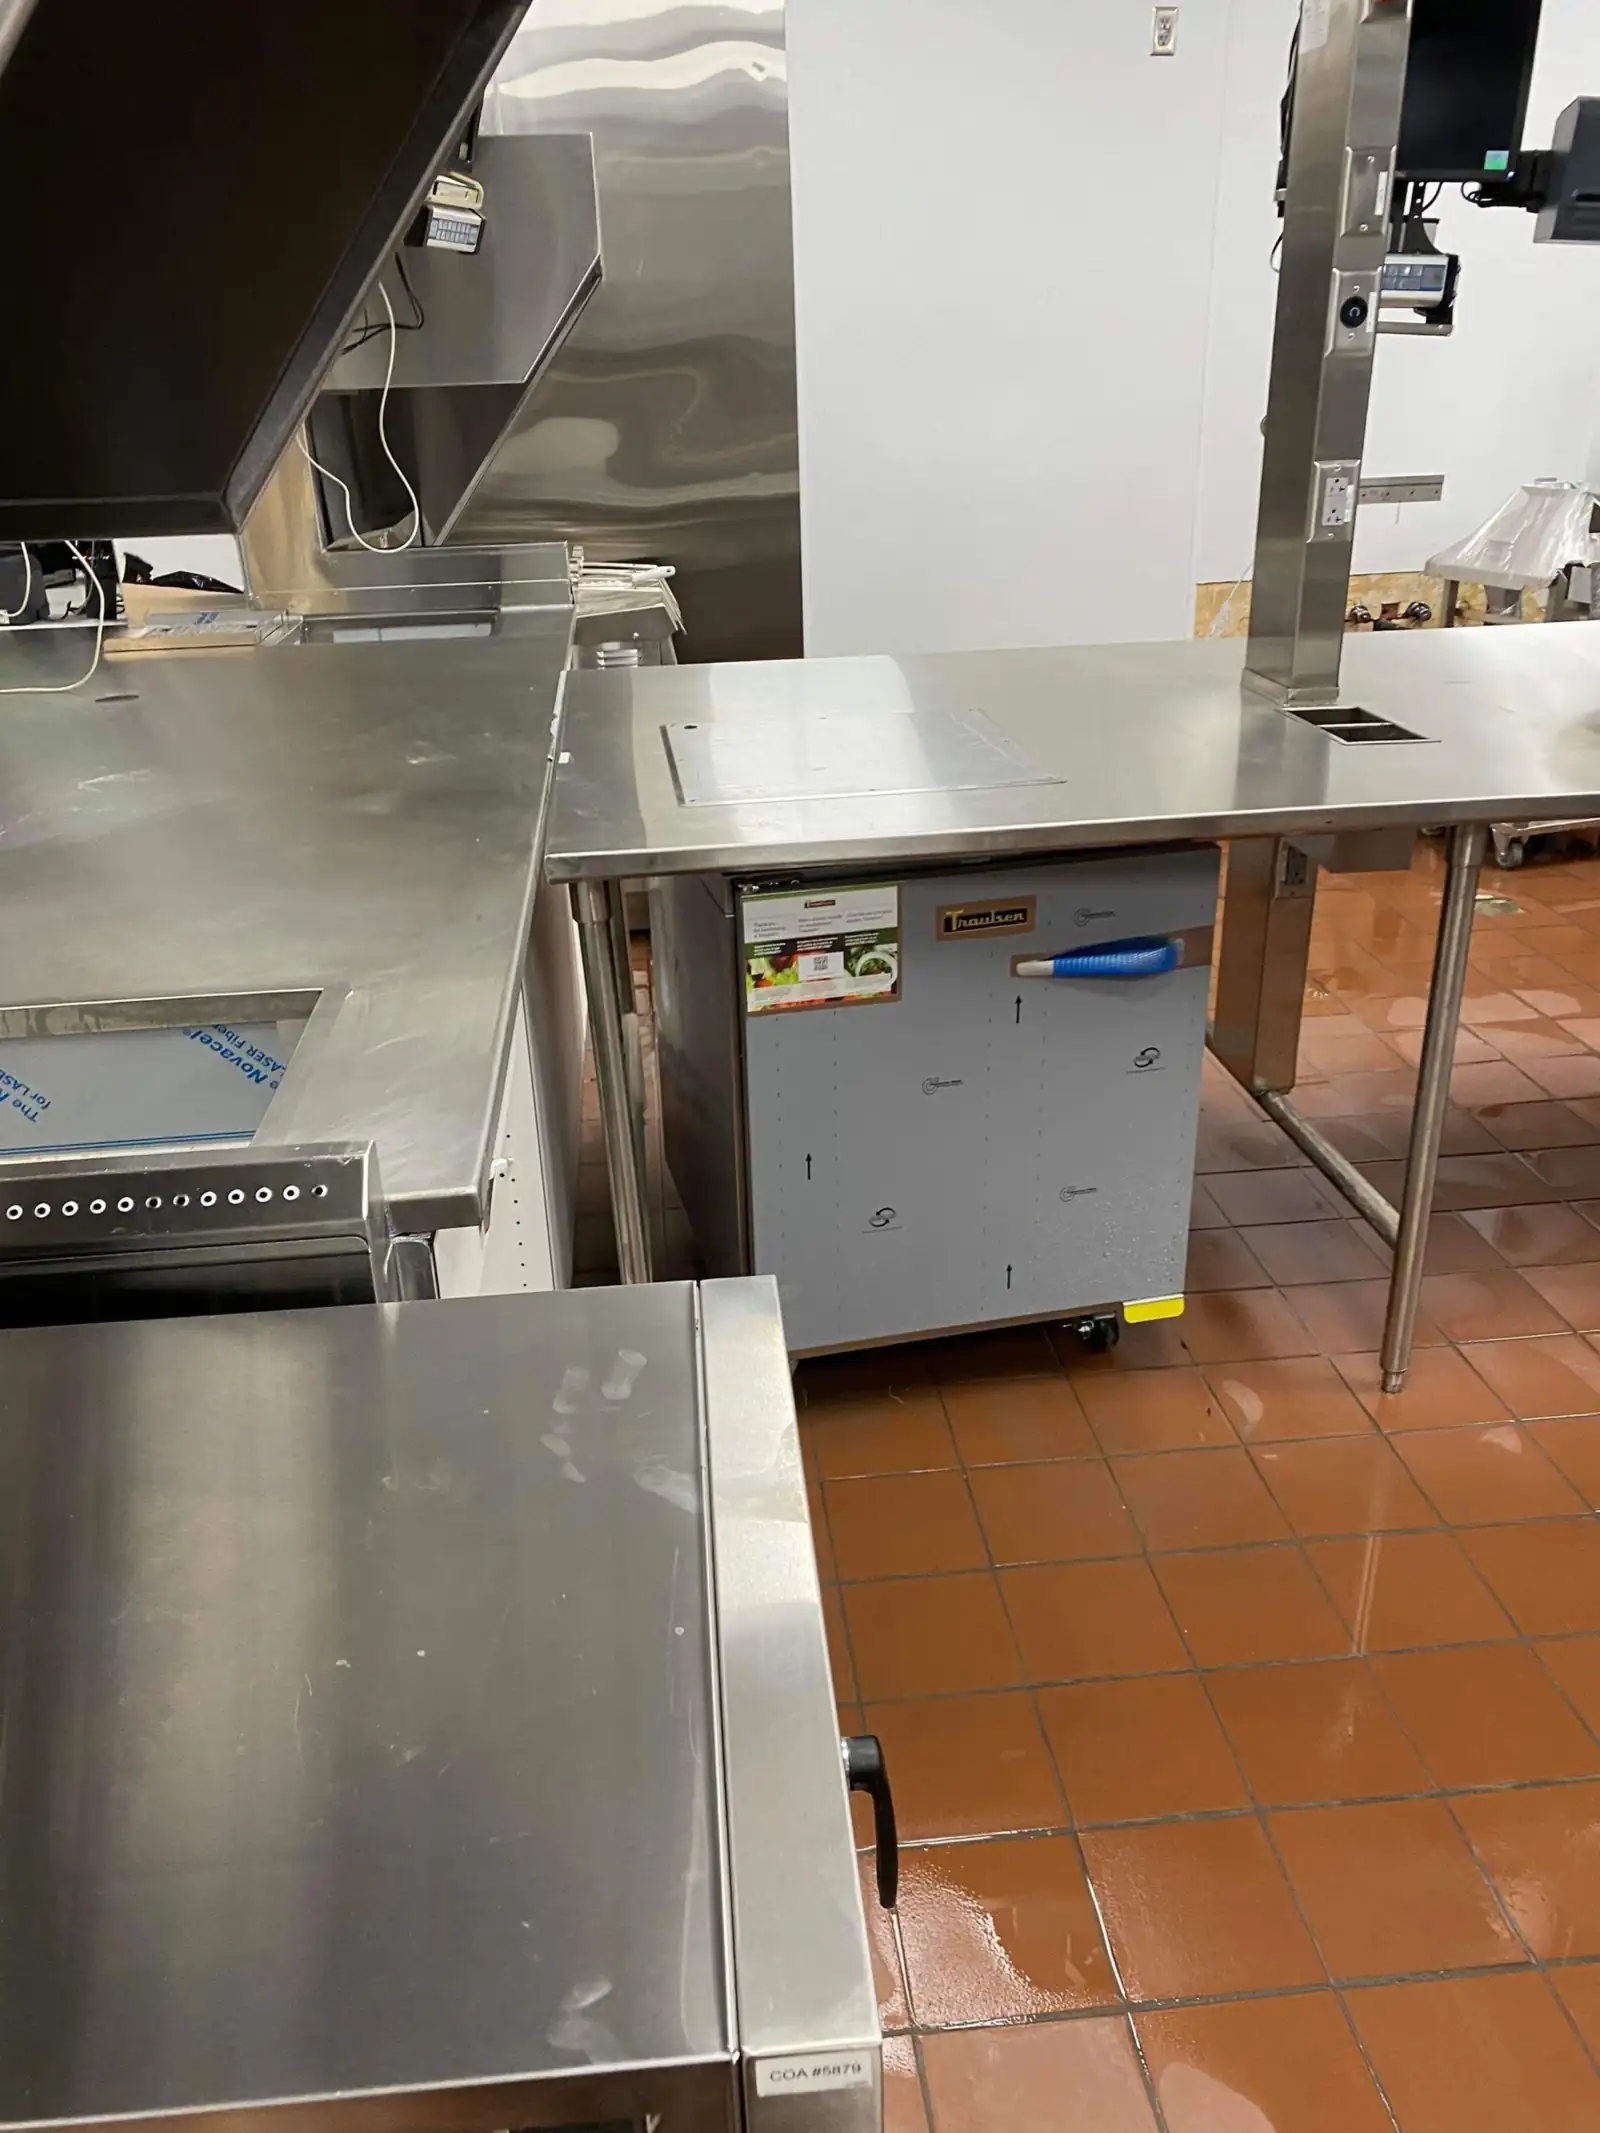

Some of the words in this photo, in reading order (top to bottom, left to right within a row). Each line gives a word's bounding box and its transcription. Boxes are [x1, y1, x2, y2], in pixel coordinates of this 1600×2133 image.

[945, 908, 1026, 931] Traulsen
[12, 1098, 39, 1123] The
[29, 1093, 51, 1110] for
[769, 2067, 809, 2082] COA
